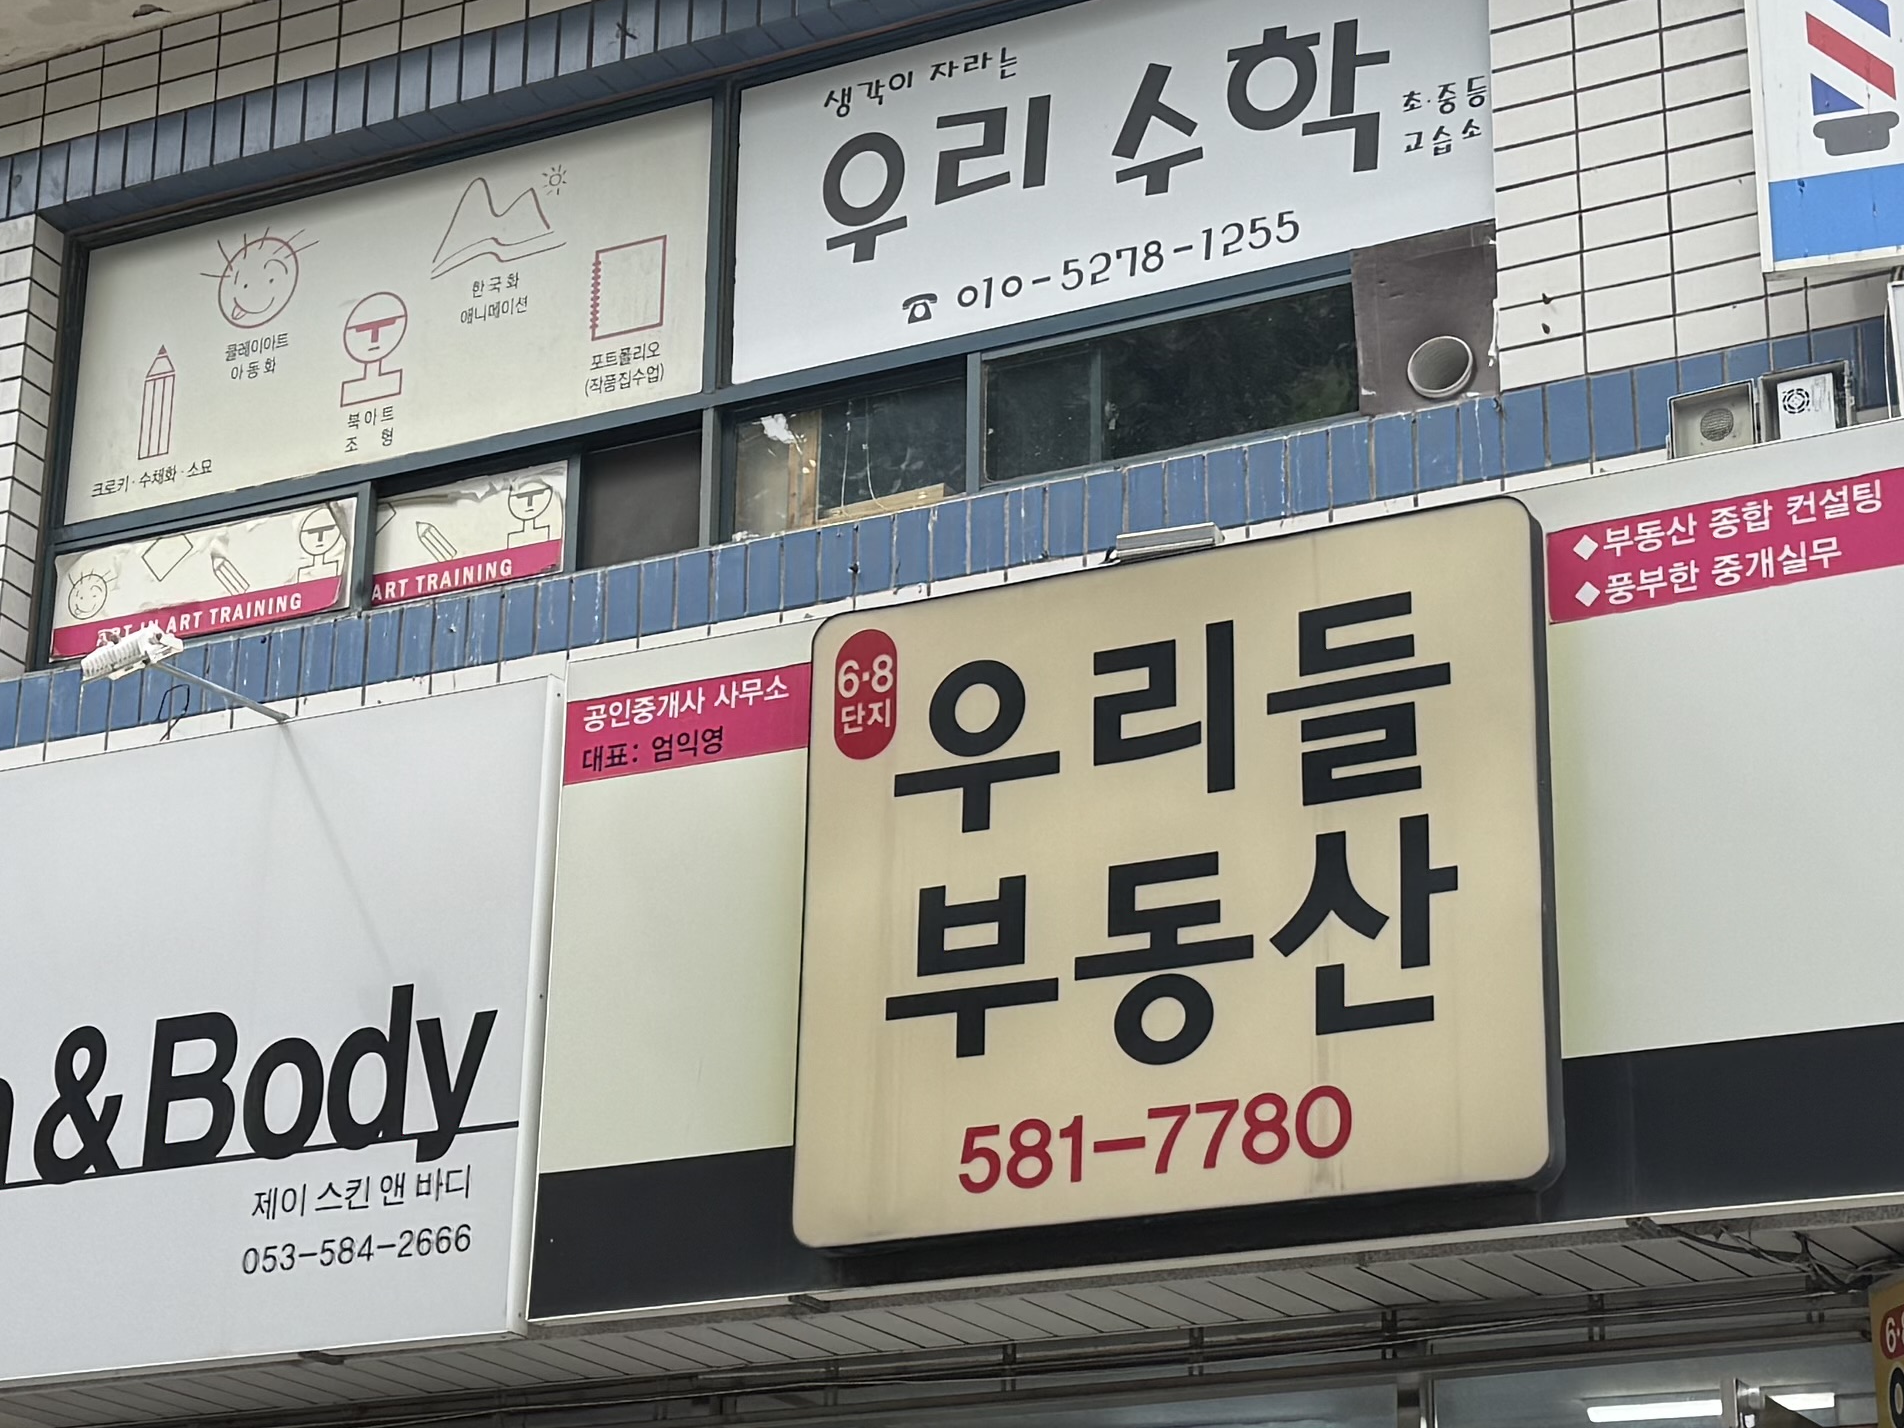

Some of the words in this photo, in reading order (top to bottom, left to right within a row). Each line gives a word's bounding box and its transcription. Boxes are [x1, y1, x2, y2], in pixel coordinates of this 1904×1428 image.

[823, 69, 914, 118] 생각이
[928, 47, 1019, 85] 자라는
[822, 93, 1052, 264] 우리
[1111, 18, 1391, 196] 수학
[957, 209, 1302, 309] 010-5278-1255
[460, 296, 529, 324] 애니메이션
[224, 333, 290, 362] 클레이아트
[590, 341, 662, 372] 포트폴리오
[584, 363, 665, 396] (작품집수업)
[1601, 506, 1699, 557] 부동산
[1711, 494, 1773, 539] 종합
[1785, 477, 1885, 530] 컨설팅
[372, 577, 410, 602] ART
[416, 557, 513, 595] TRAINING
[1601, 556, 1699, 607] 풍부한
[1711, 538, 1843, 589] 중개실무
[165, 609, 202, 634] ART
[209, 592, 303, 626] TRAINING
[582, 685, 707, 733] 공인중개사
[713, 673, 791, 715] 사무소
[839, 699, 896, 736] 단지
[894, 592, 1452, 834] 우리들
[651, 723, 726, 764] 엄익영
[884, 814, 1460, 1067] 부동산
[958, 1083, 1353, 1197] 581-7780
[415, 1163, 473, 1205] 바디
[241, 1224, 473, 1278] 053-584-2666
